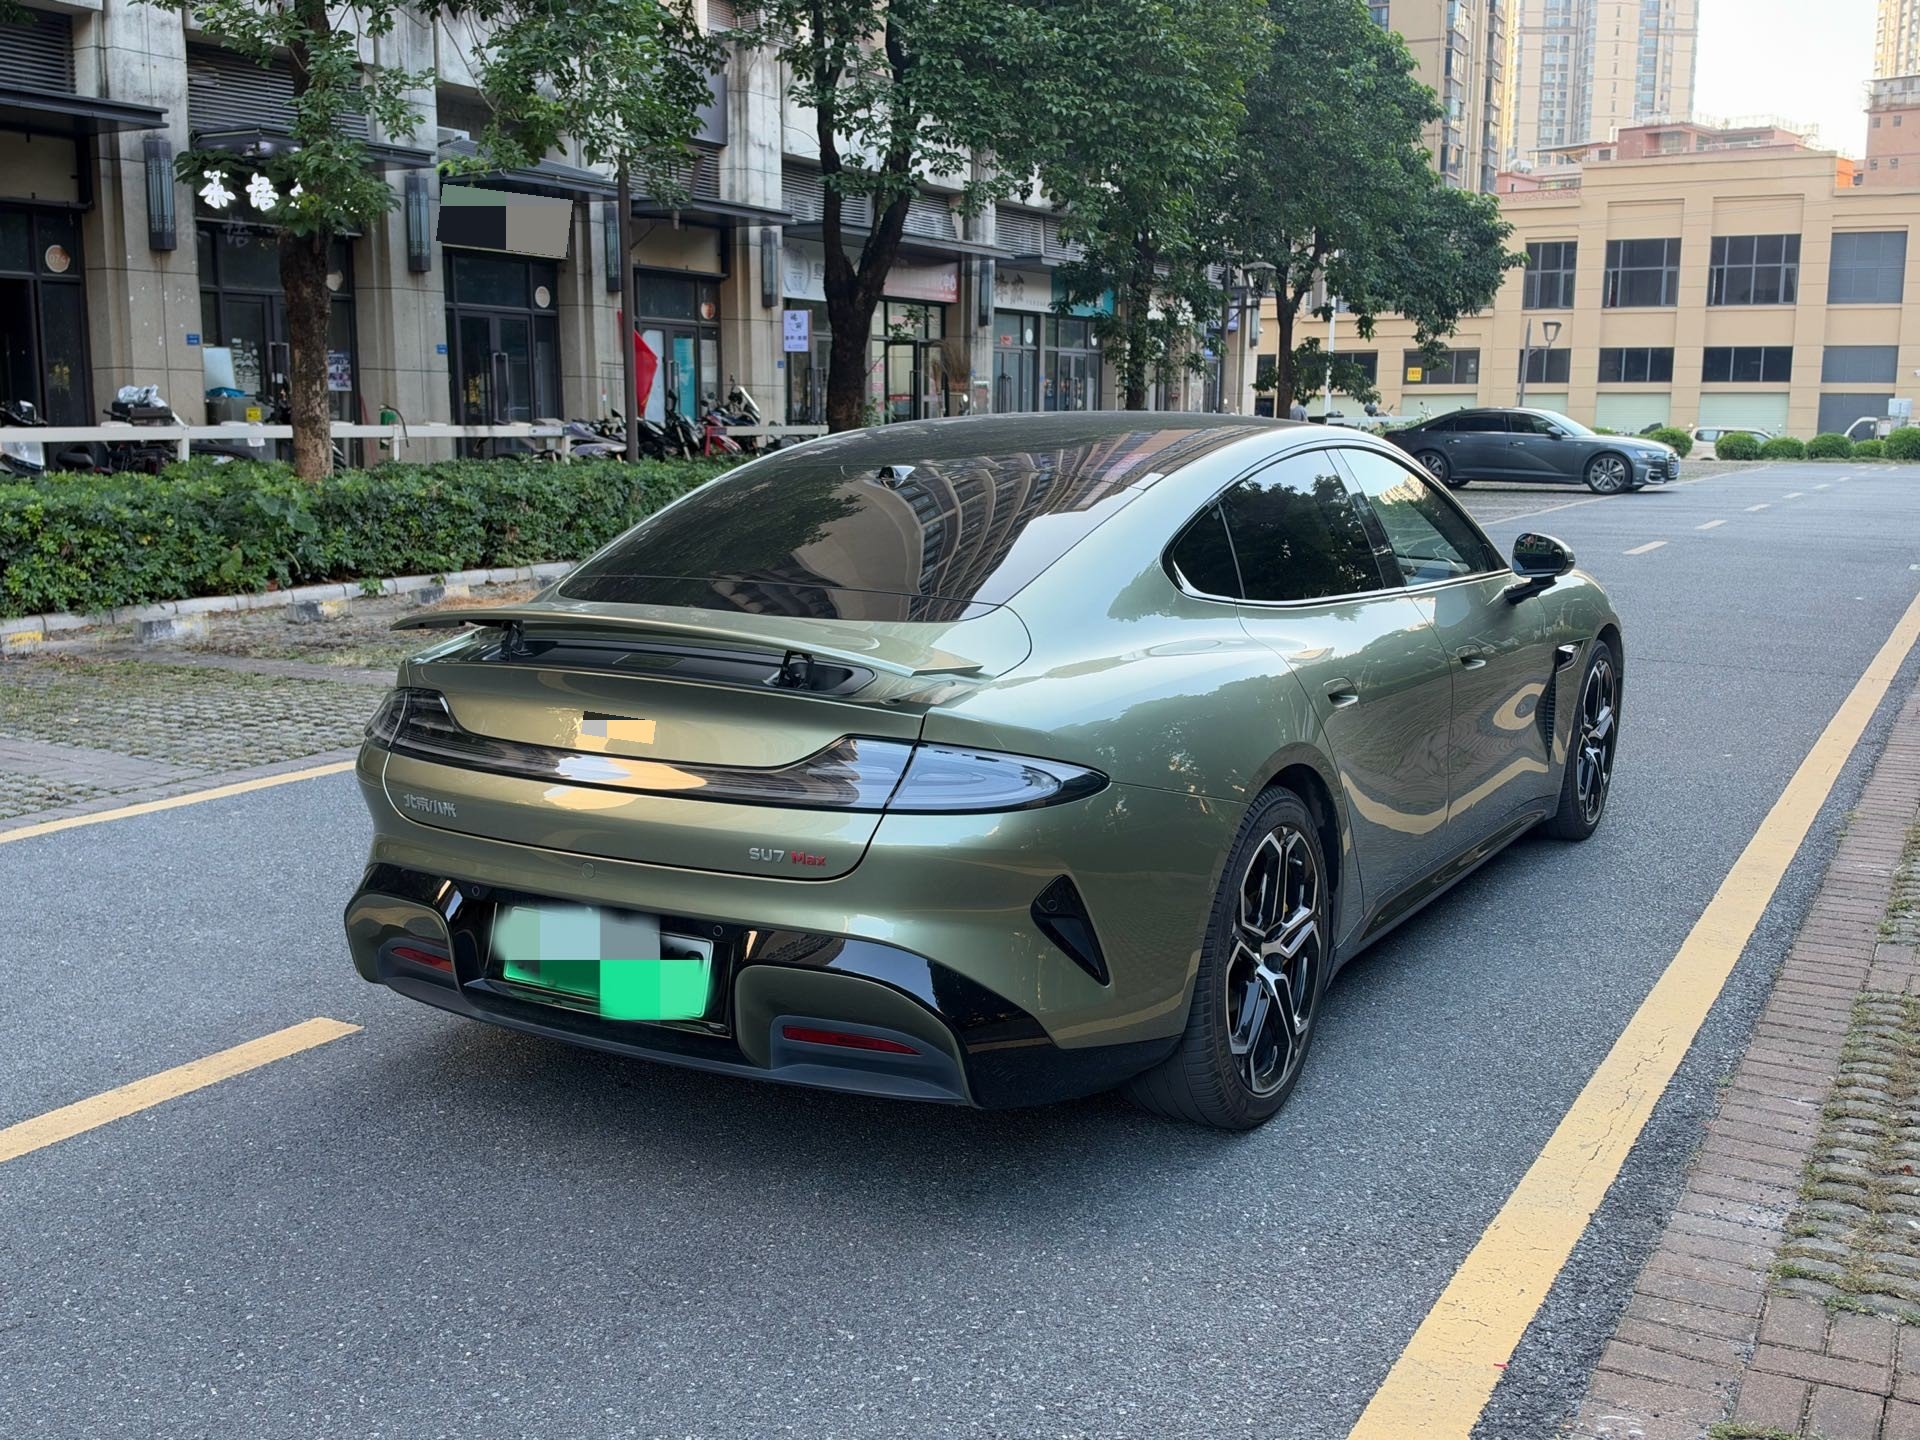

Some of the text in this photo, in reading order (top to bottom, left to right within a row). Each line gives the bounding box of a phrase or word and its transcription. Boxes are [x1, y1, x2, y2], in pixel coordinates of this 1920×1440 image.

[403, 793, 457, 818] 北京小米
[748, 846, 826, 867] SU7 Max
